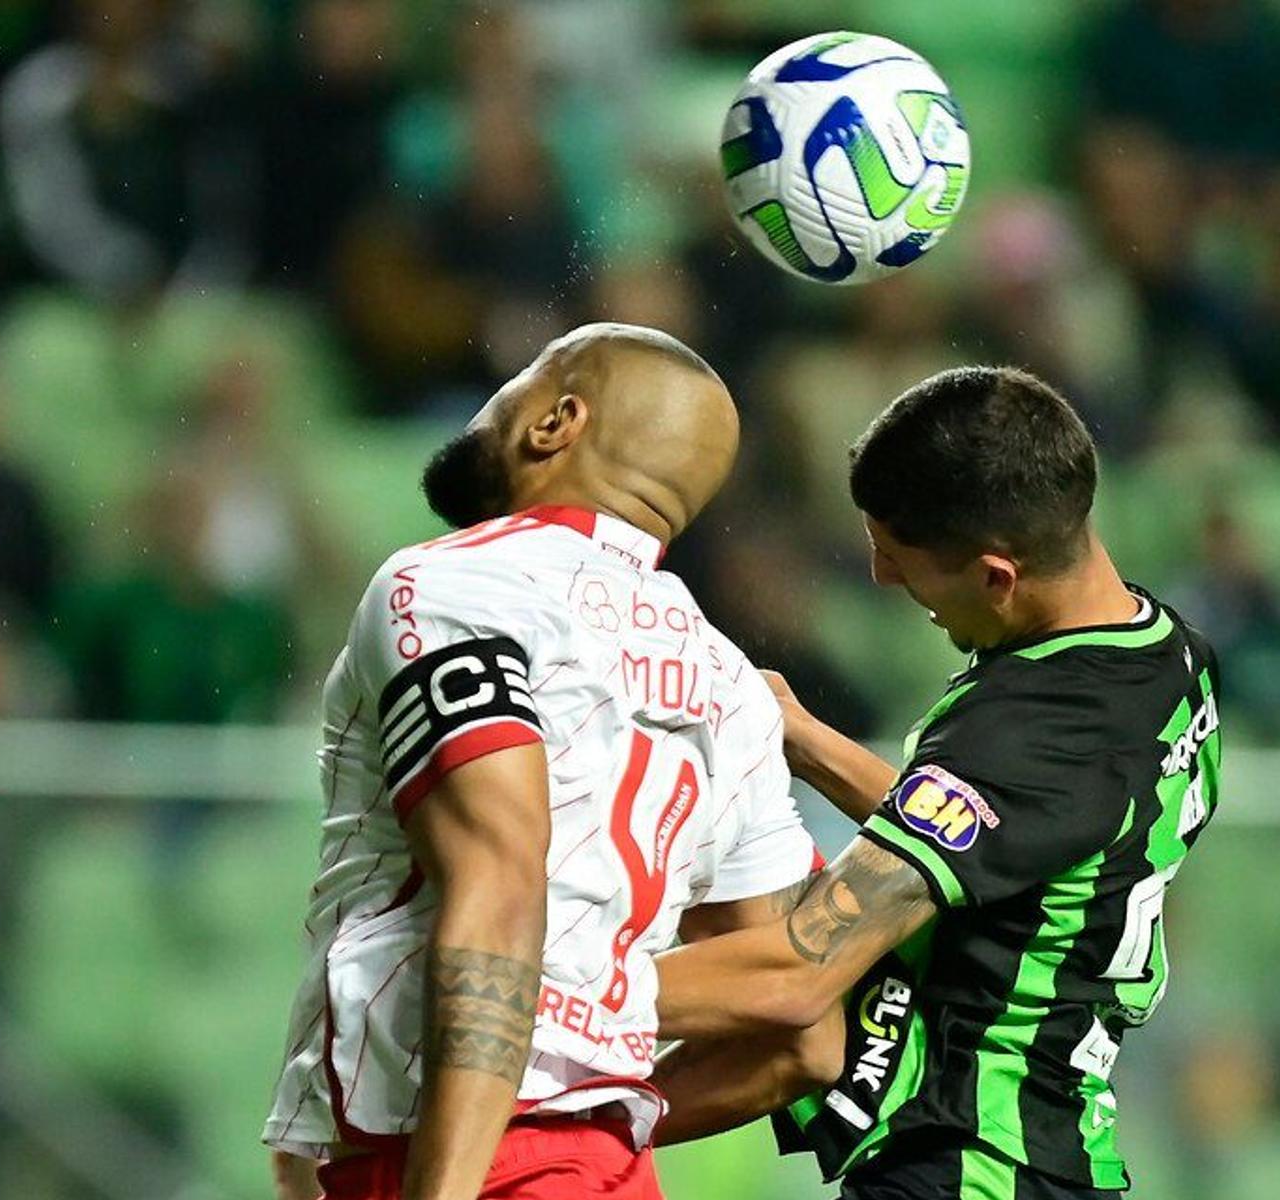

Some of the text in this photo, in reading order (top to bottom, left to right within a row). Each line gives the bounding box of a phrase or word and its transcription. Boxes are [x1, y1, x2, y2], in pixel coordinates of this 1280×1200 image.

[390, 563, 423, 660] vero
[429, 655, 497, 716] C
[902, 778, 976, 843] BH
